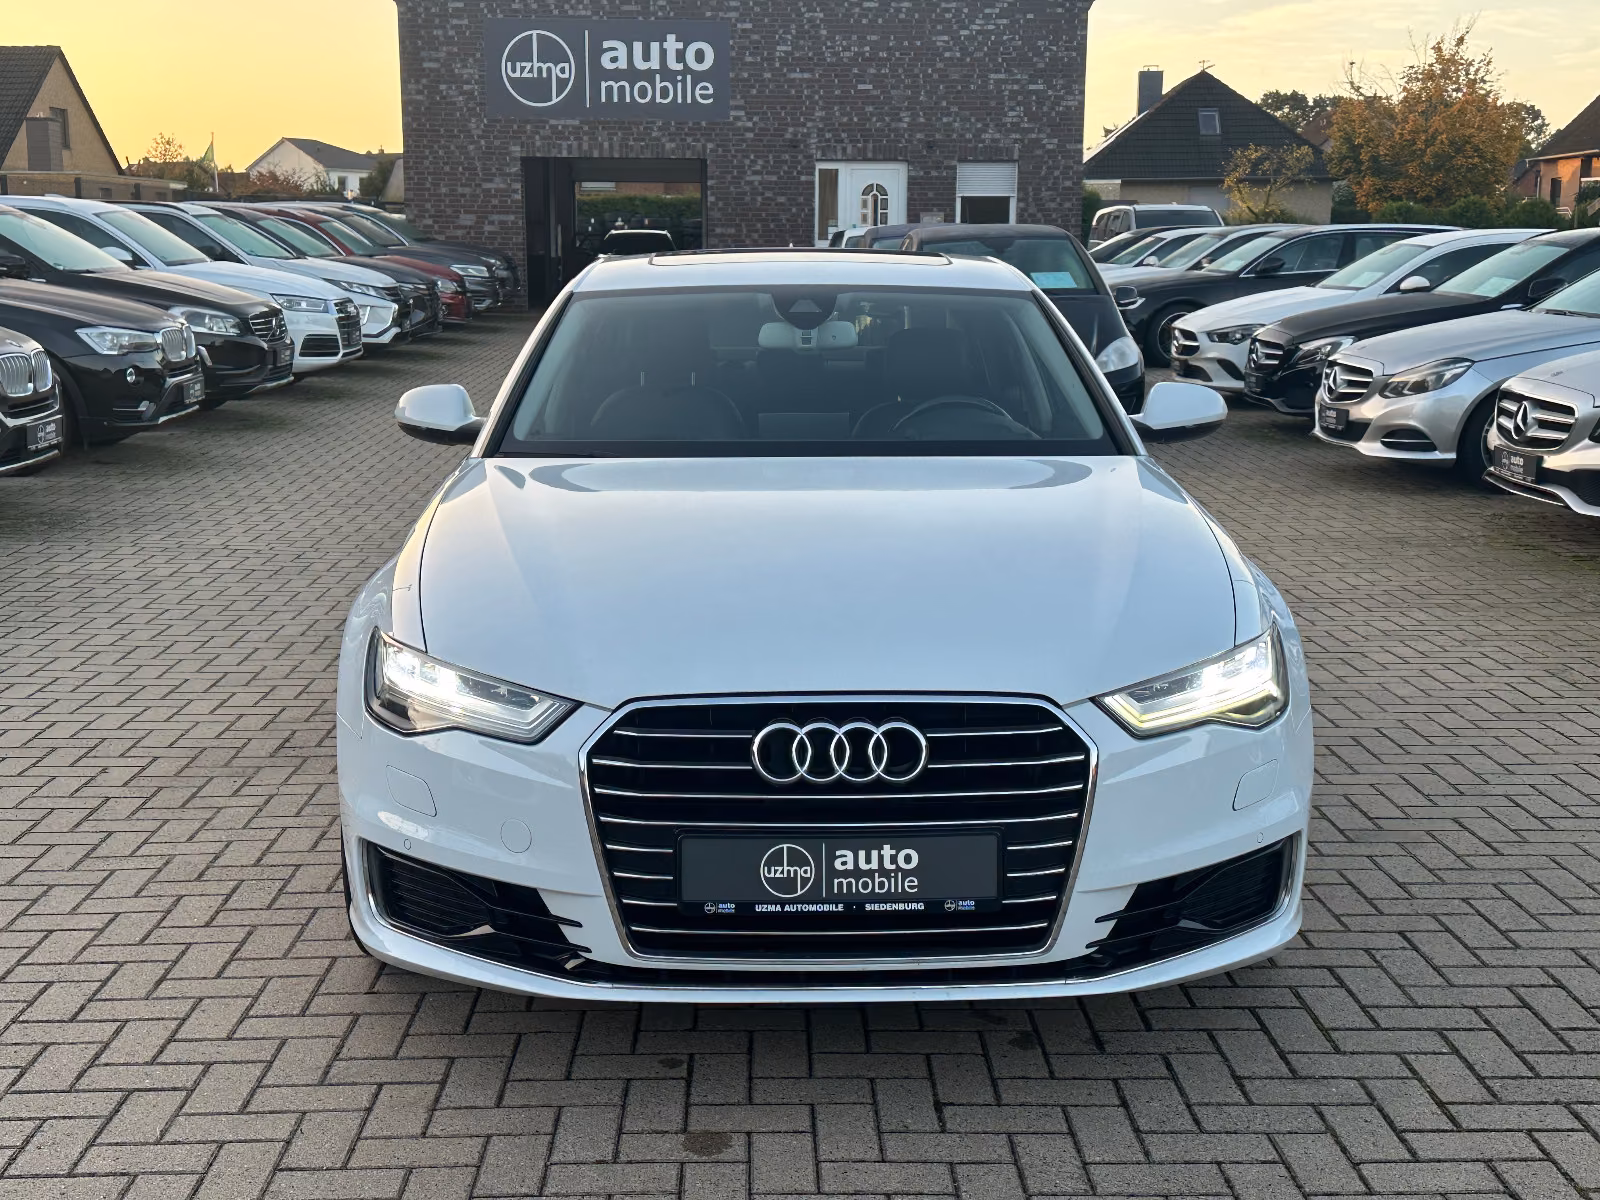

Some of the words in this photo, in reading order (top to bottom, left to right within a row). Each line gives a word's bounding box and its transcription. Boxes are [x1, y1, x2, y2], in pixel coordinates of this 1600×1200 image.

[600, 33, 715, 71] auto
[600, 73, 714, 104] mobile
[834, 844, 919, 870] auto
[833, 872, 919, 893] mobile
[755, 904, 781, 912] UZMA
[783, 903, 844, 912] AUTOMOBILE
[865, 902, 925, 911] SIEDENBURG
